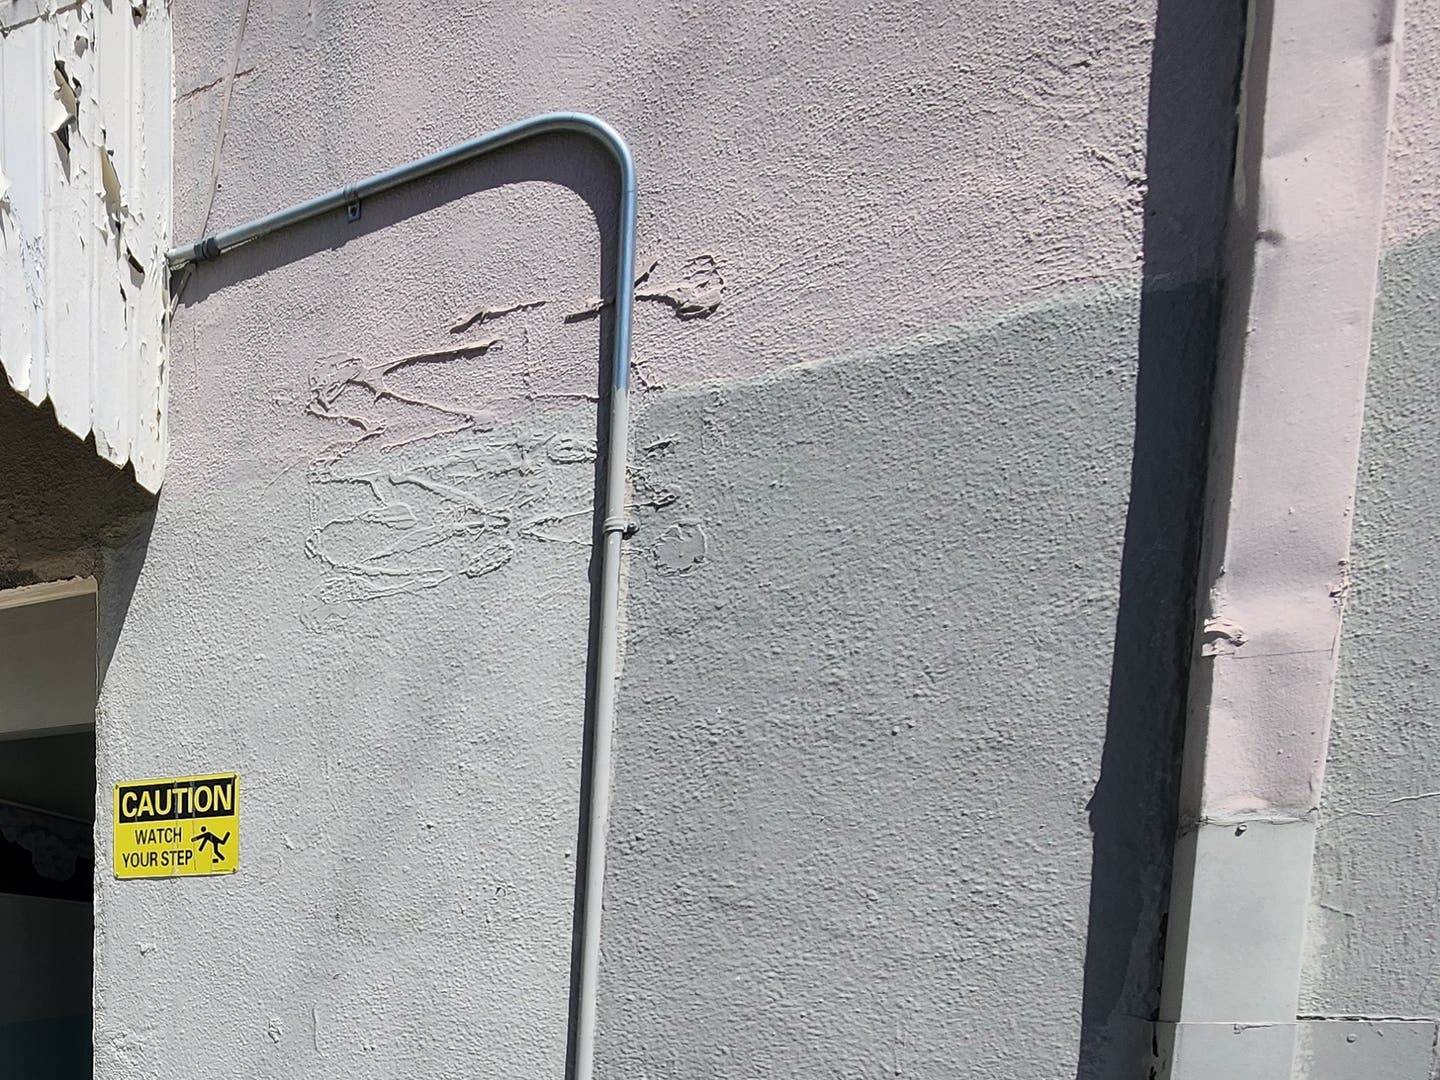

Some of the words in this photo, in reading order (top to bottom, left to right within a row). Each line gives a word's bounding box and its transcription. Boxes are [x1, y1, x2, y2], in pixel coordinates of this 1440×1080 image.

[121, 783, 233, 818] CAUTION
[134, 827, 182, 845] WATCH
[122, 851, 158, 868] YOUR
[160, 850, 193, 867] STEP
